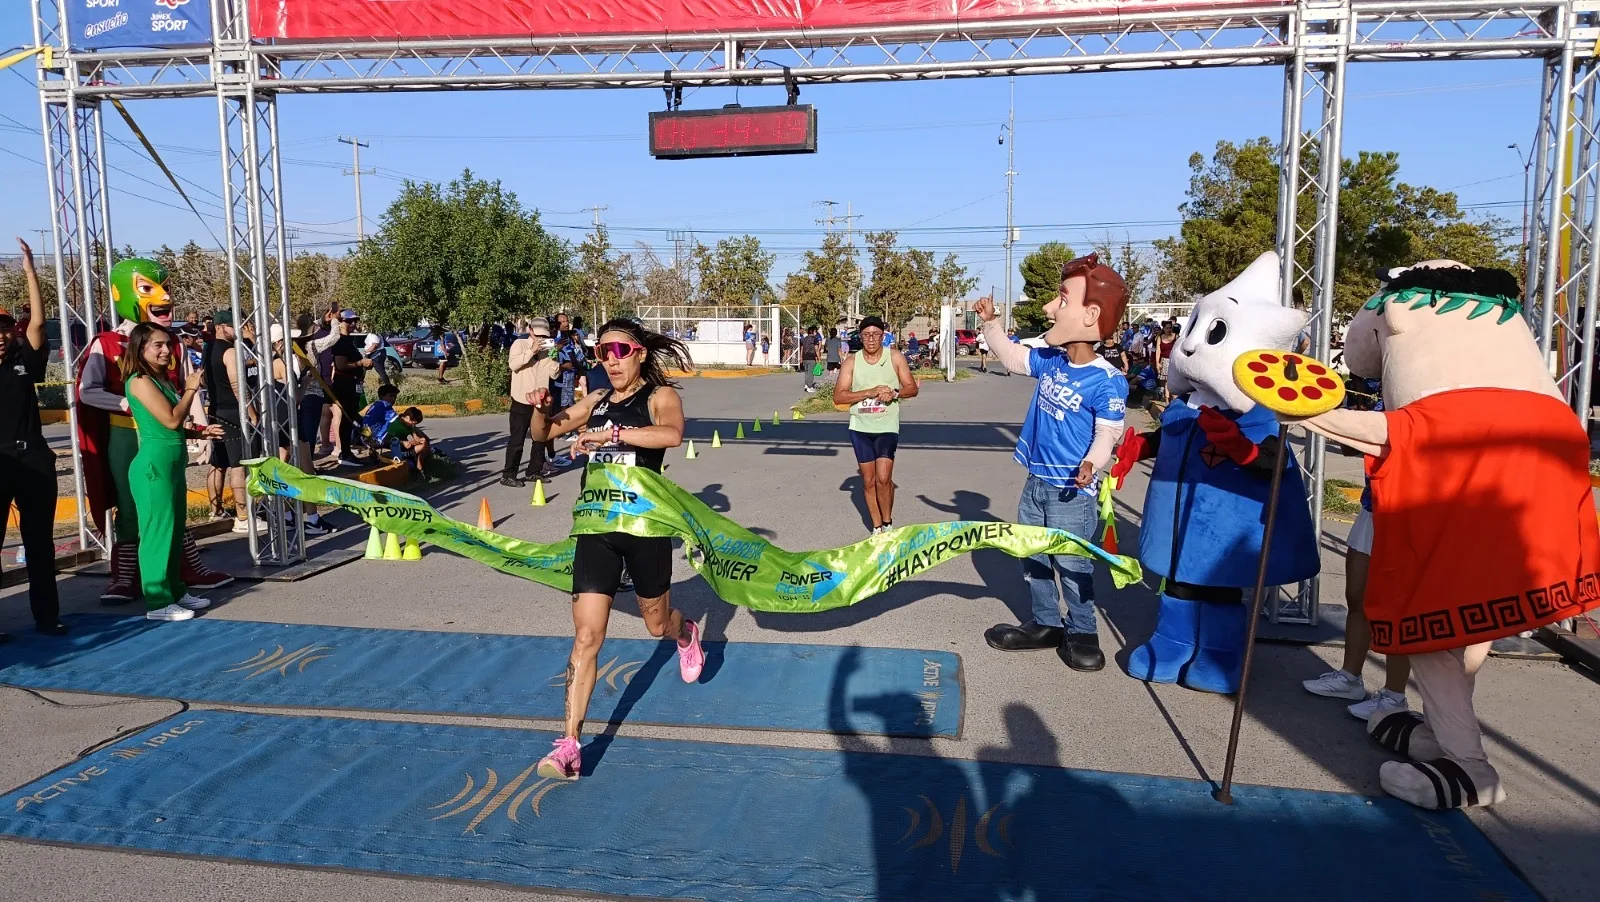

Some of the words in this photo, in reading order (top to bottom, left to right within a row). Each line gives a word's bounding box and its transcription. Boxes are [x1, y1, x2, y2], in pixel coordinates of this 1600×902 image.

[152, 19, 189, 32] SPORT
[885, 523, 1014, 588] #HAYPOWER
[780, 570, 832, 586] POWER
[16, 765, 109, 812] ACTIVE
